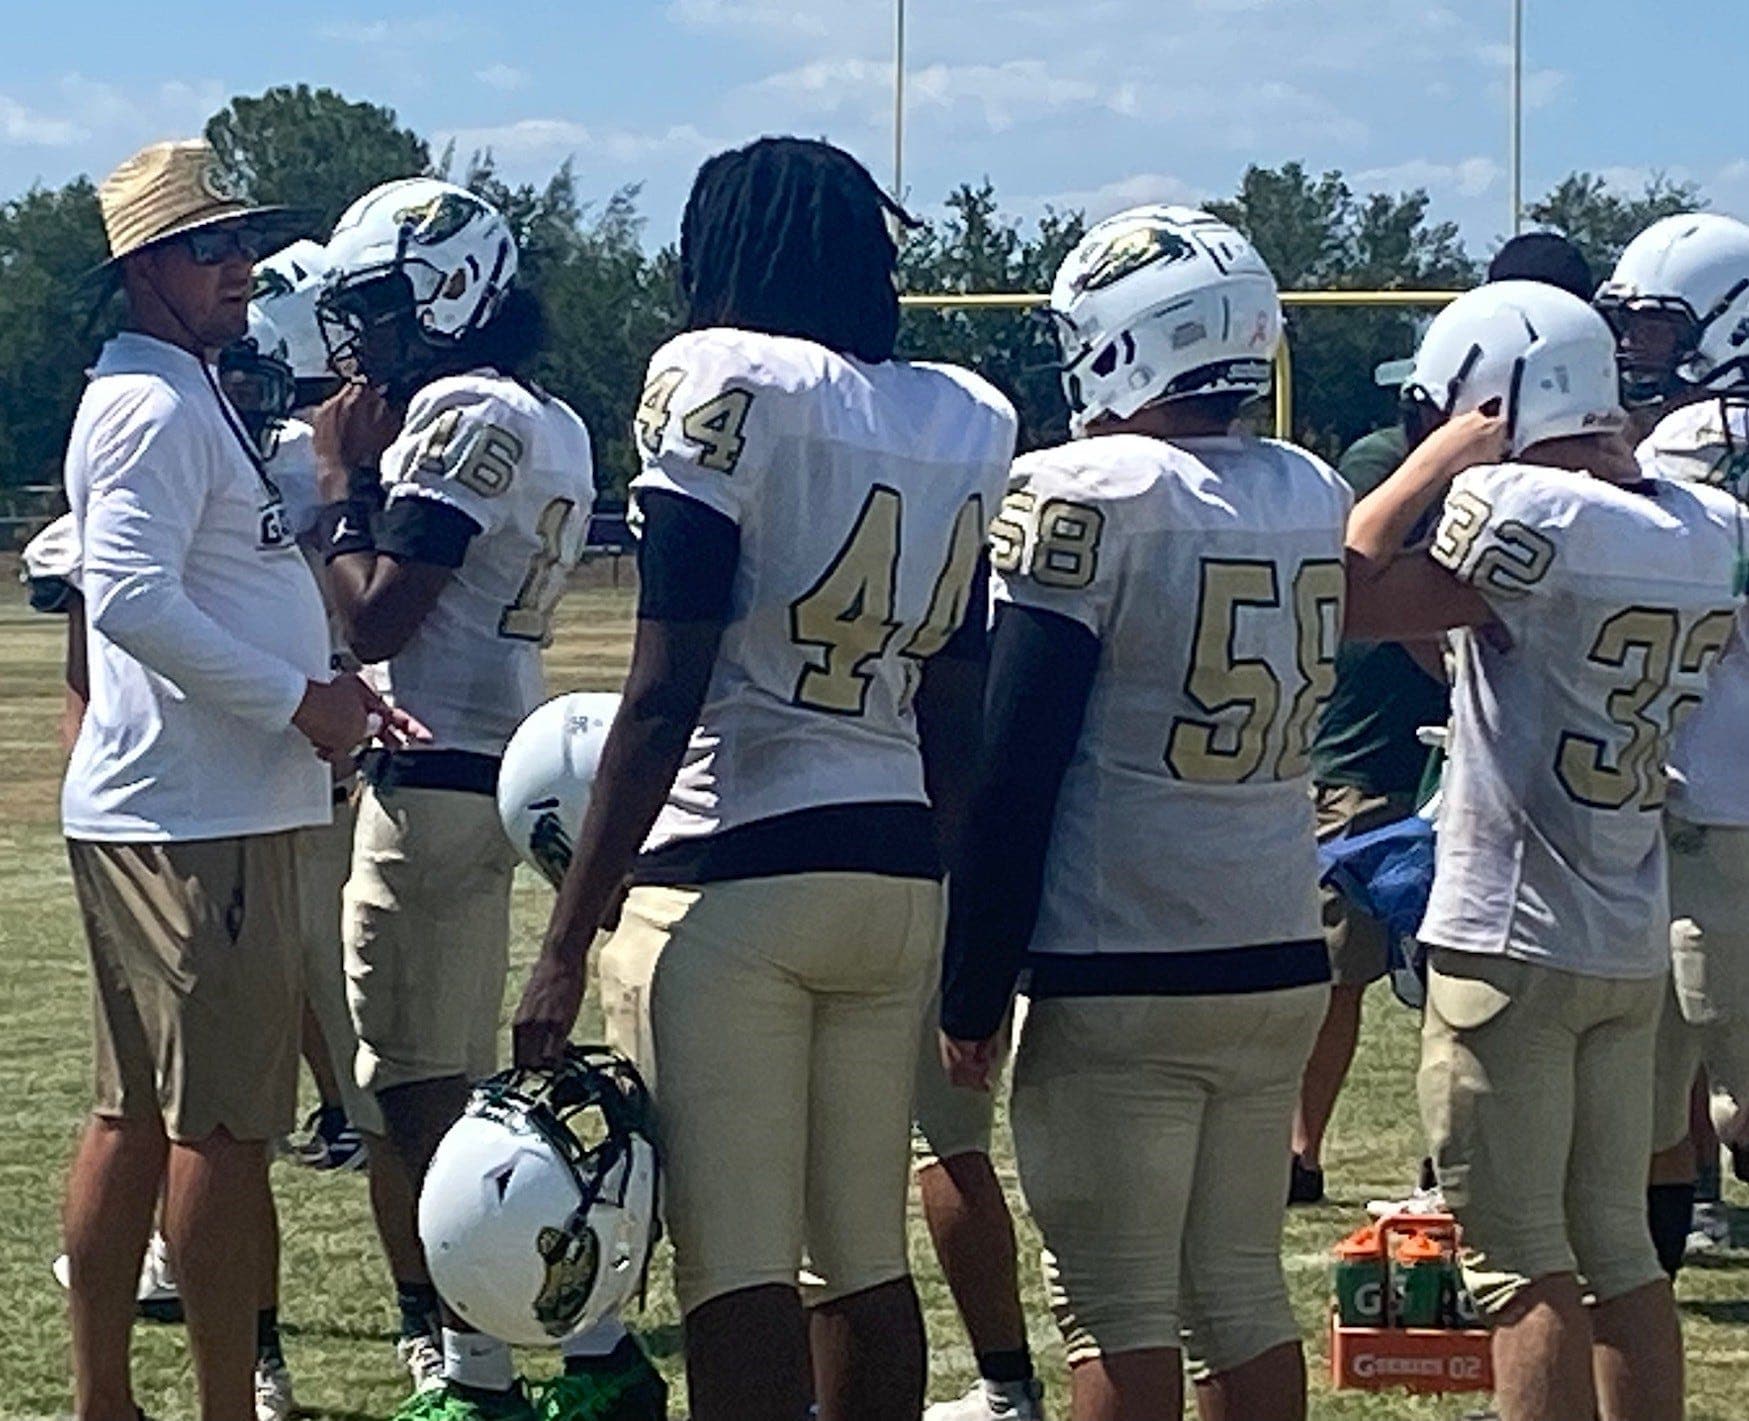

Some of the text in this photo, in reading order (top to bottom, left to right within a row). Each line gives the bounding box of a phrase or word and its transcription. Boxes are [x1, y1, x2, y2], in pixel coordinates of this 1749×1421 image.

[417, 409, 524, 498] 16
[636, 366, 754, 476] 44
[988, 489, 1105, 589] 58
[1428, 491, 1554, 598] 32
[1354, 1282, 1382, 1316] G
